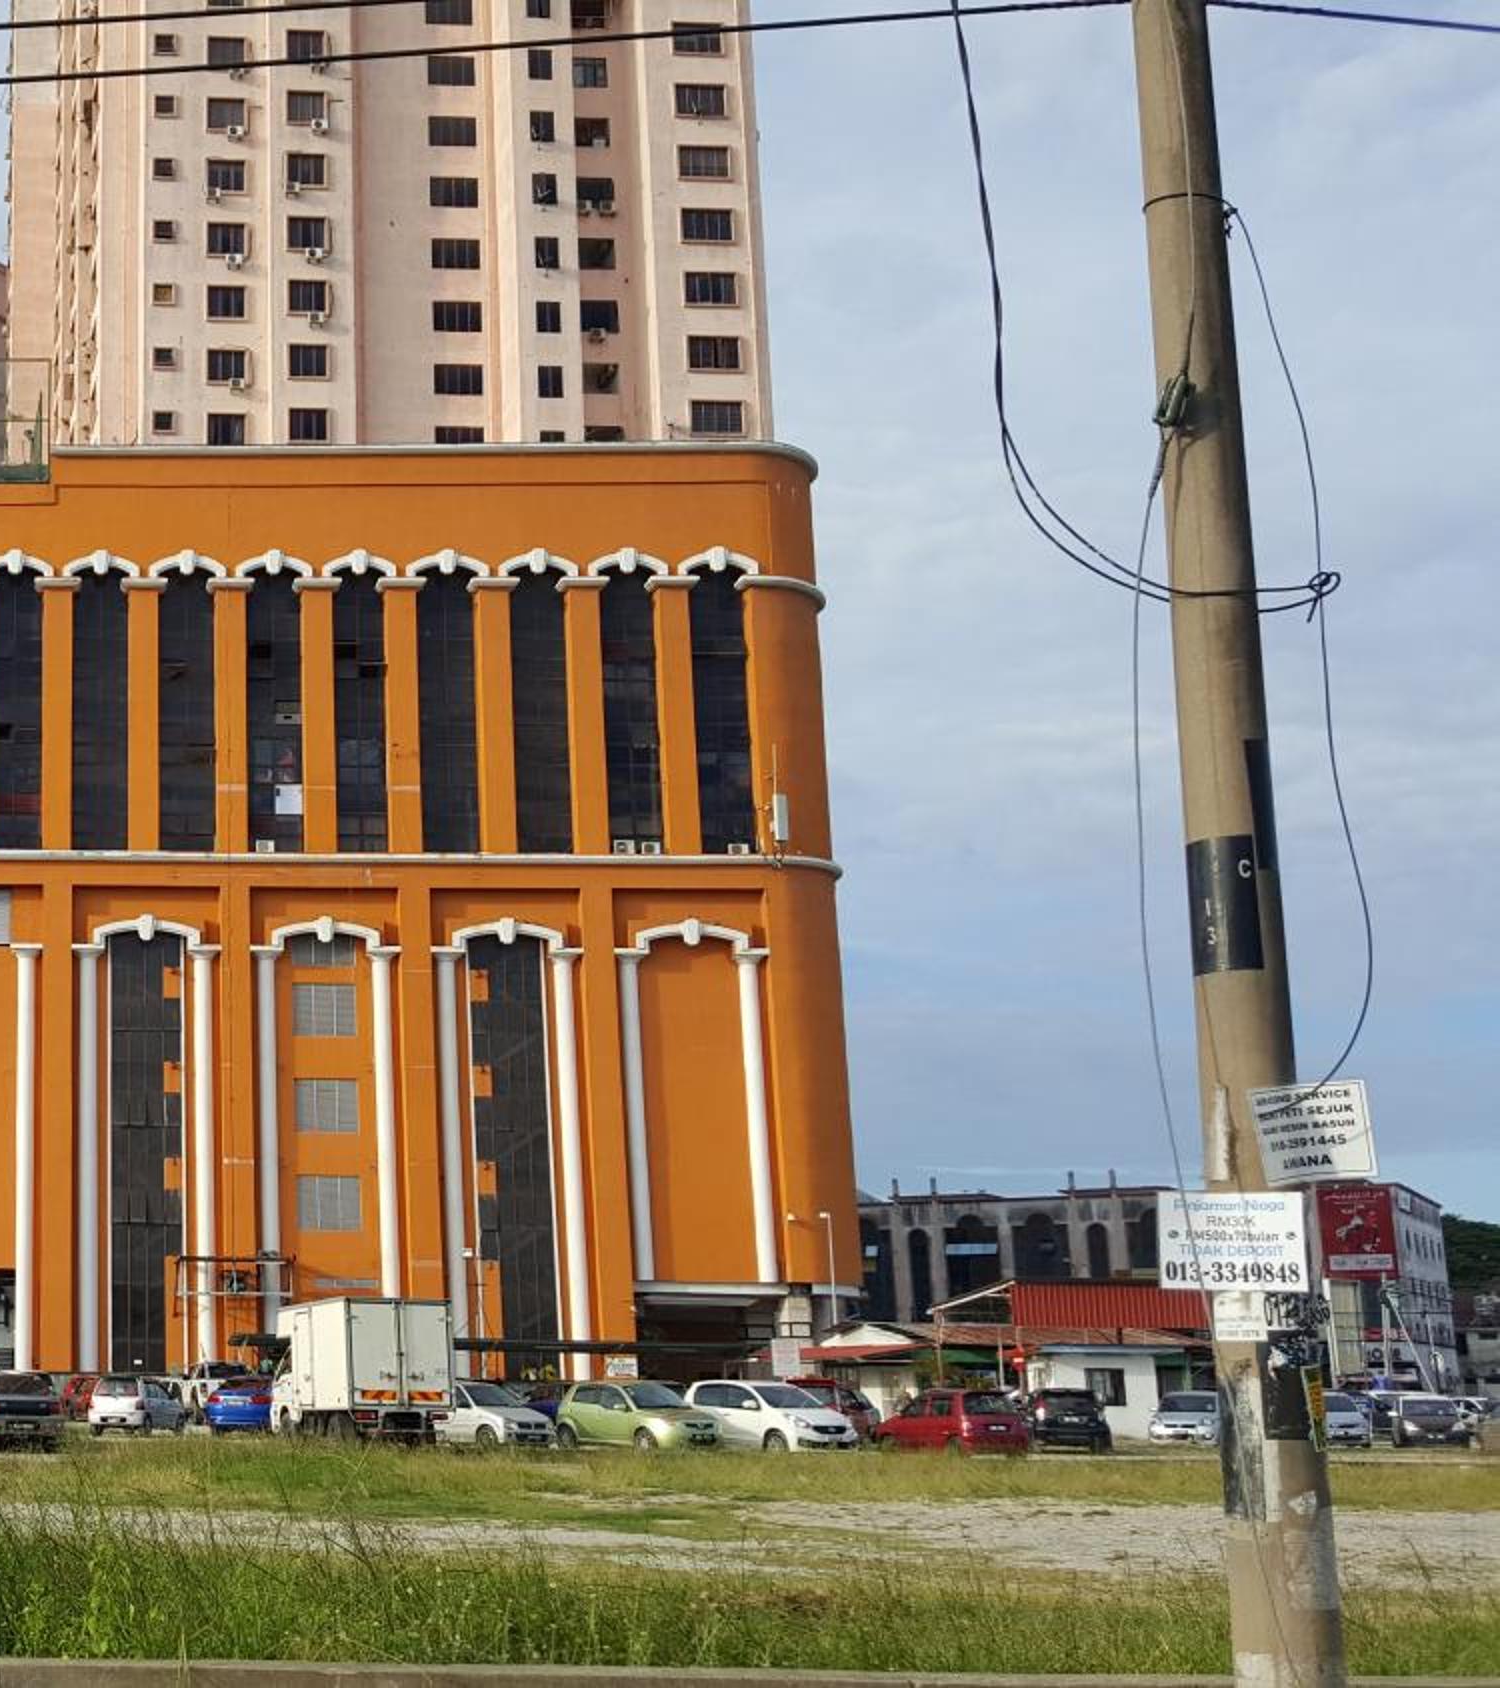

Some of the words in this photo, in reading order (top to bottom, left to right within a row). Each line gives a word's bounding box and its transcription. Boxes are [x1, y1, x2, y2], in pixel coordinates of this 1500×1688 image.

[1307, 1103, 1355, 1115] SEJUK
[1312, 1118, 1356, 1129] BASUH
[1180, 1244, 1223, 1257] TIDAK
[1227, 1245, 1284, 1257] DEPOSIT
[1165, 1260, 1301, 1284] 013-3349848
